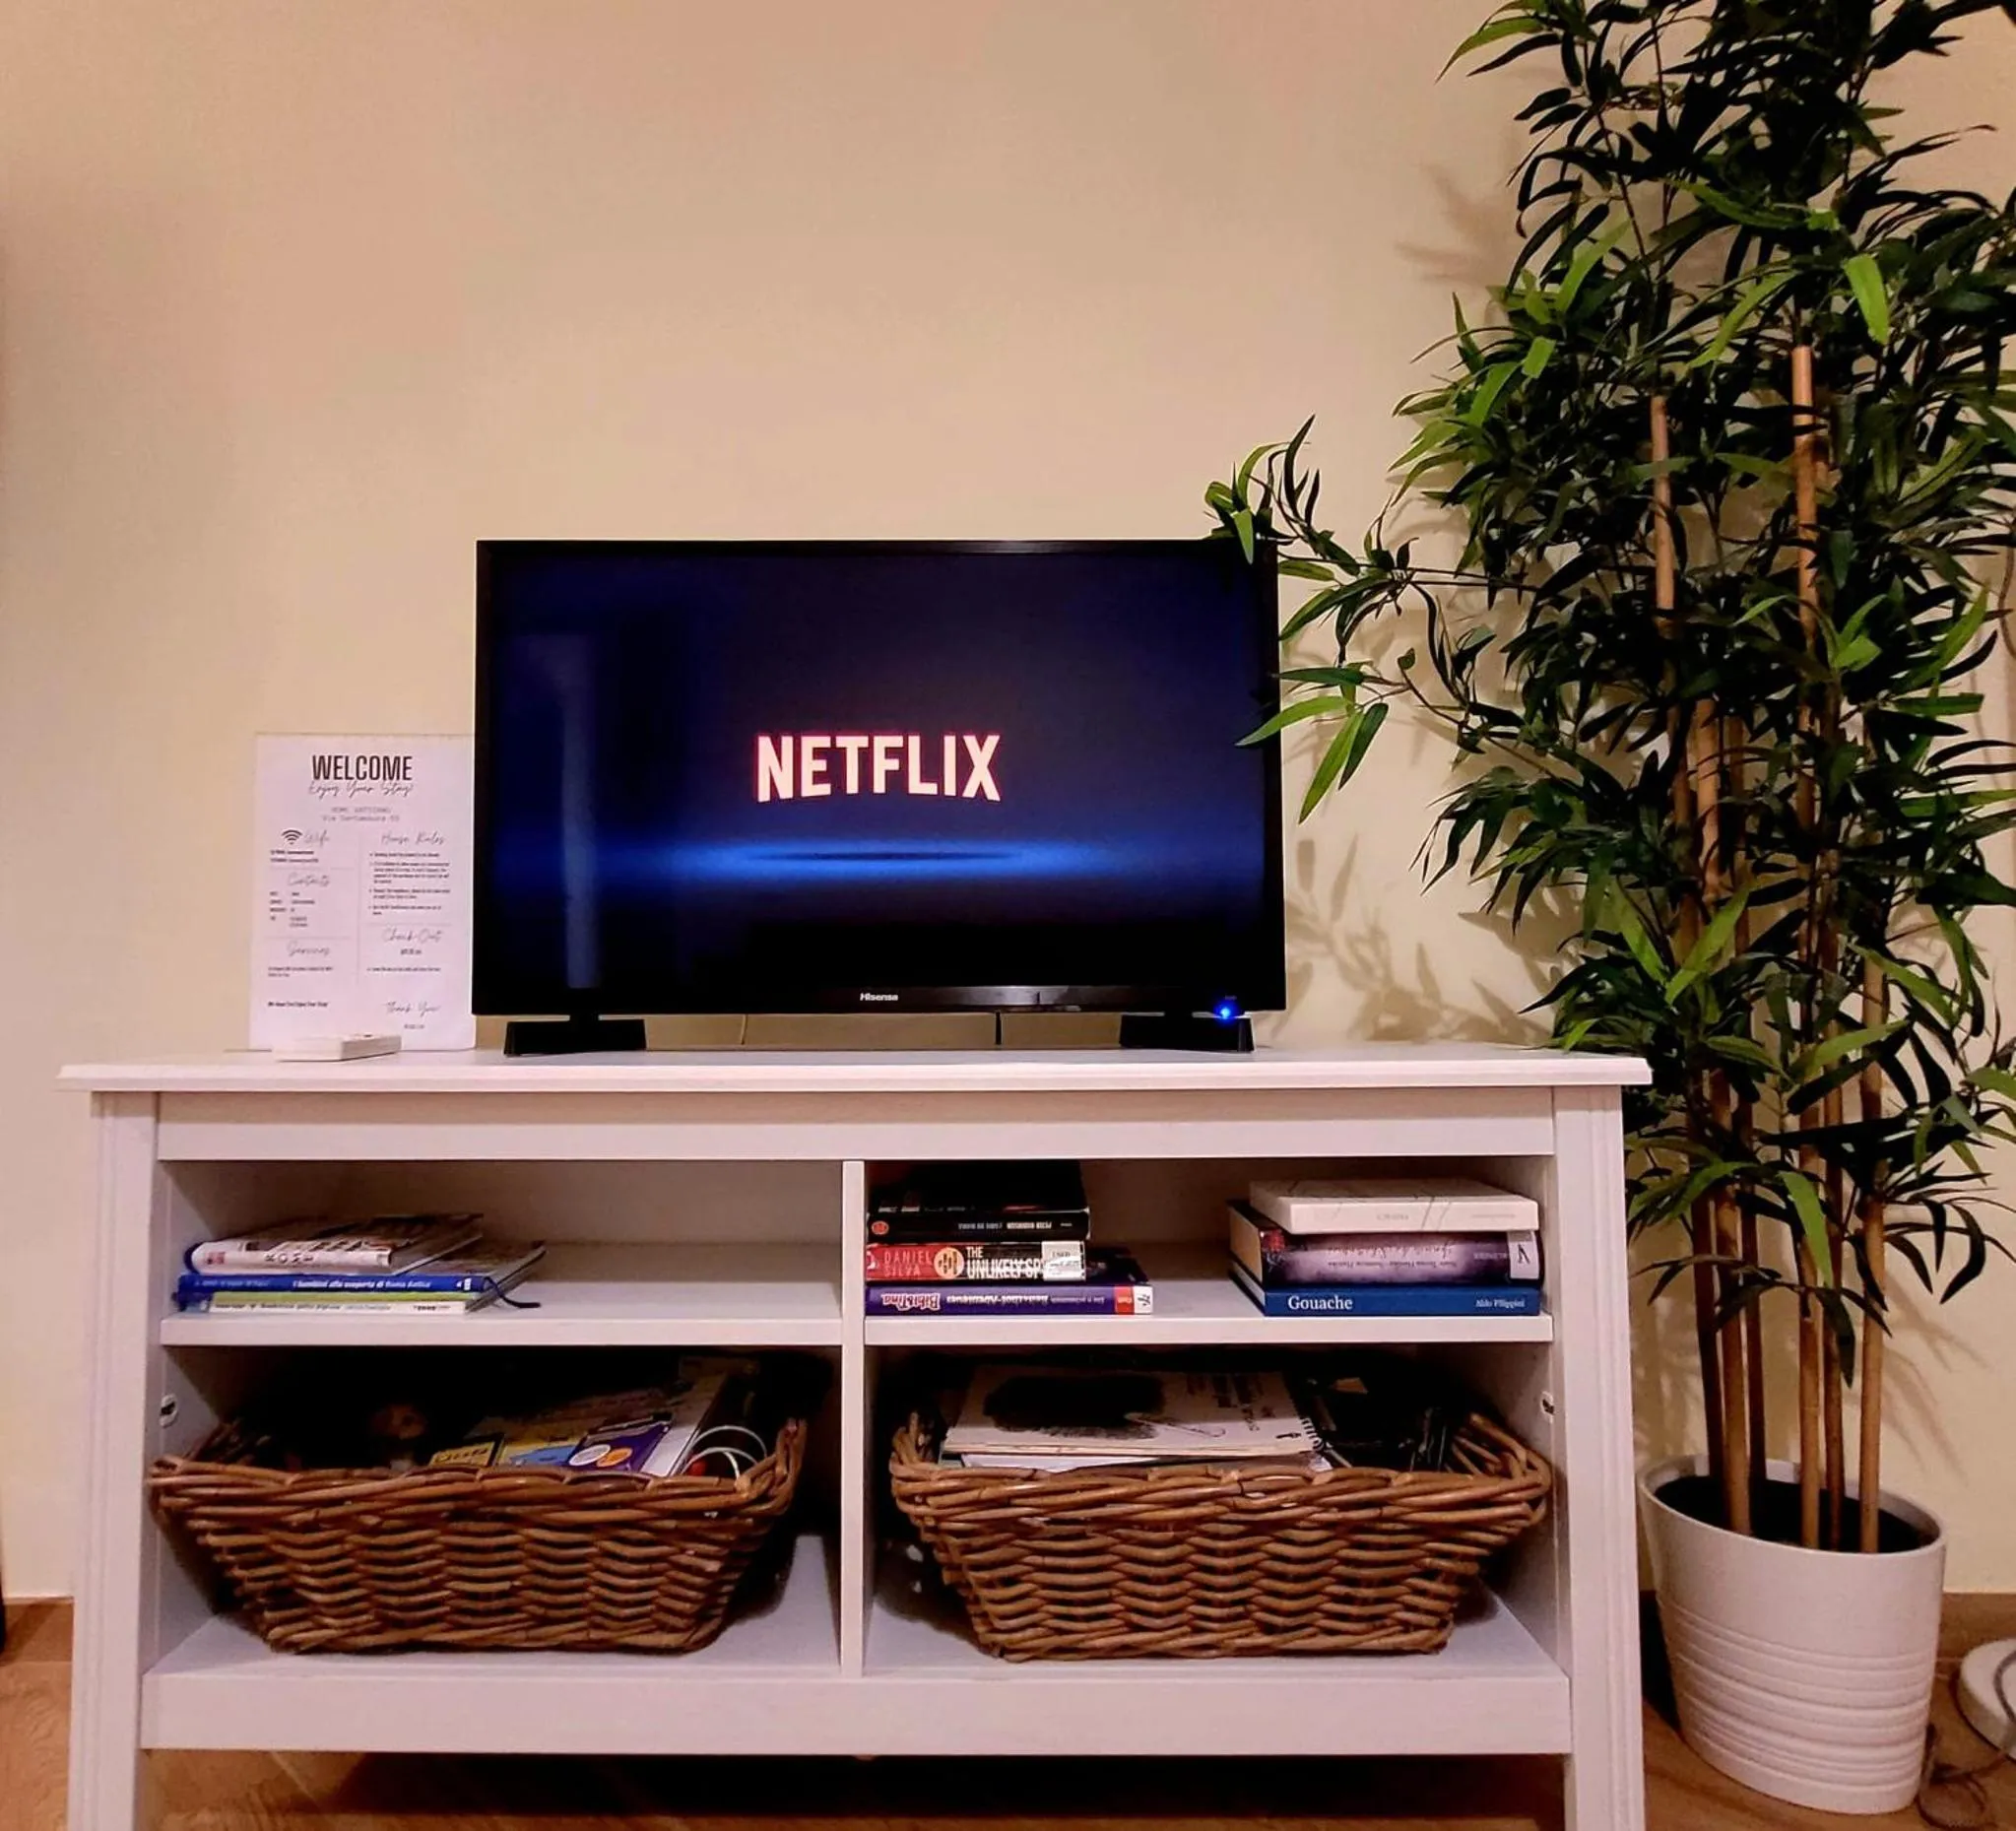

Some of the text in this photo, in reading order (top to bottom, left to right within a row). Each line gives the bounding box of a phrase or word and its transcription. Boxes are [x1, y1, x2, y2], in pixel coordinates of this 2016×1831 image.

[312, 754, 414, 781] WELCOME
[756, 734, 1002, 803] NETFLIX
[308, 780, 340, 800] Enjoy
[346, 780, 375, 799] Your
[860, 992, 899, 1002] Hisense
[885, 1250, 933, 1265] DANIEL
[966, 1246, 984, 1259] THE
[885, 1264, 921, 1276] SILVA
[966, 1258, 1026, 1279] UNLIKELY
[1287, 1294, 1354, 1311] Gouache
[1475, 1298, 1493, 1308] Aldo
